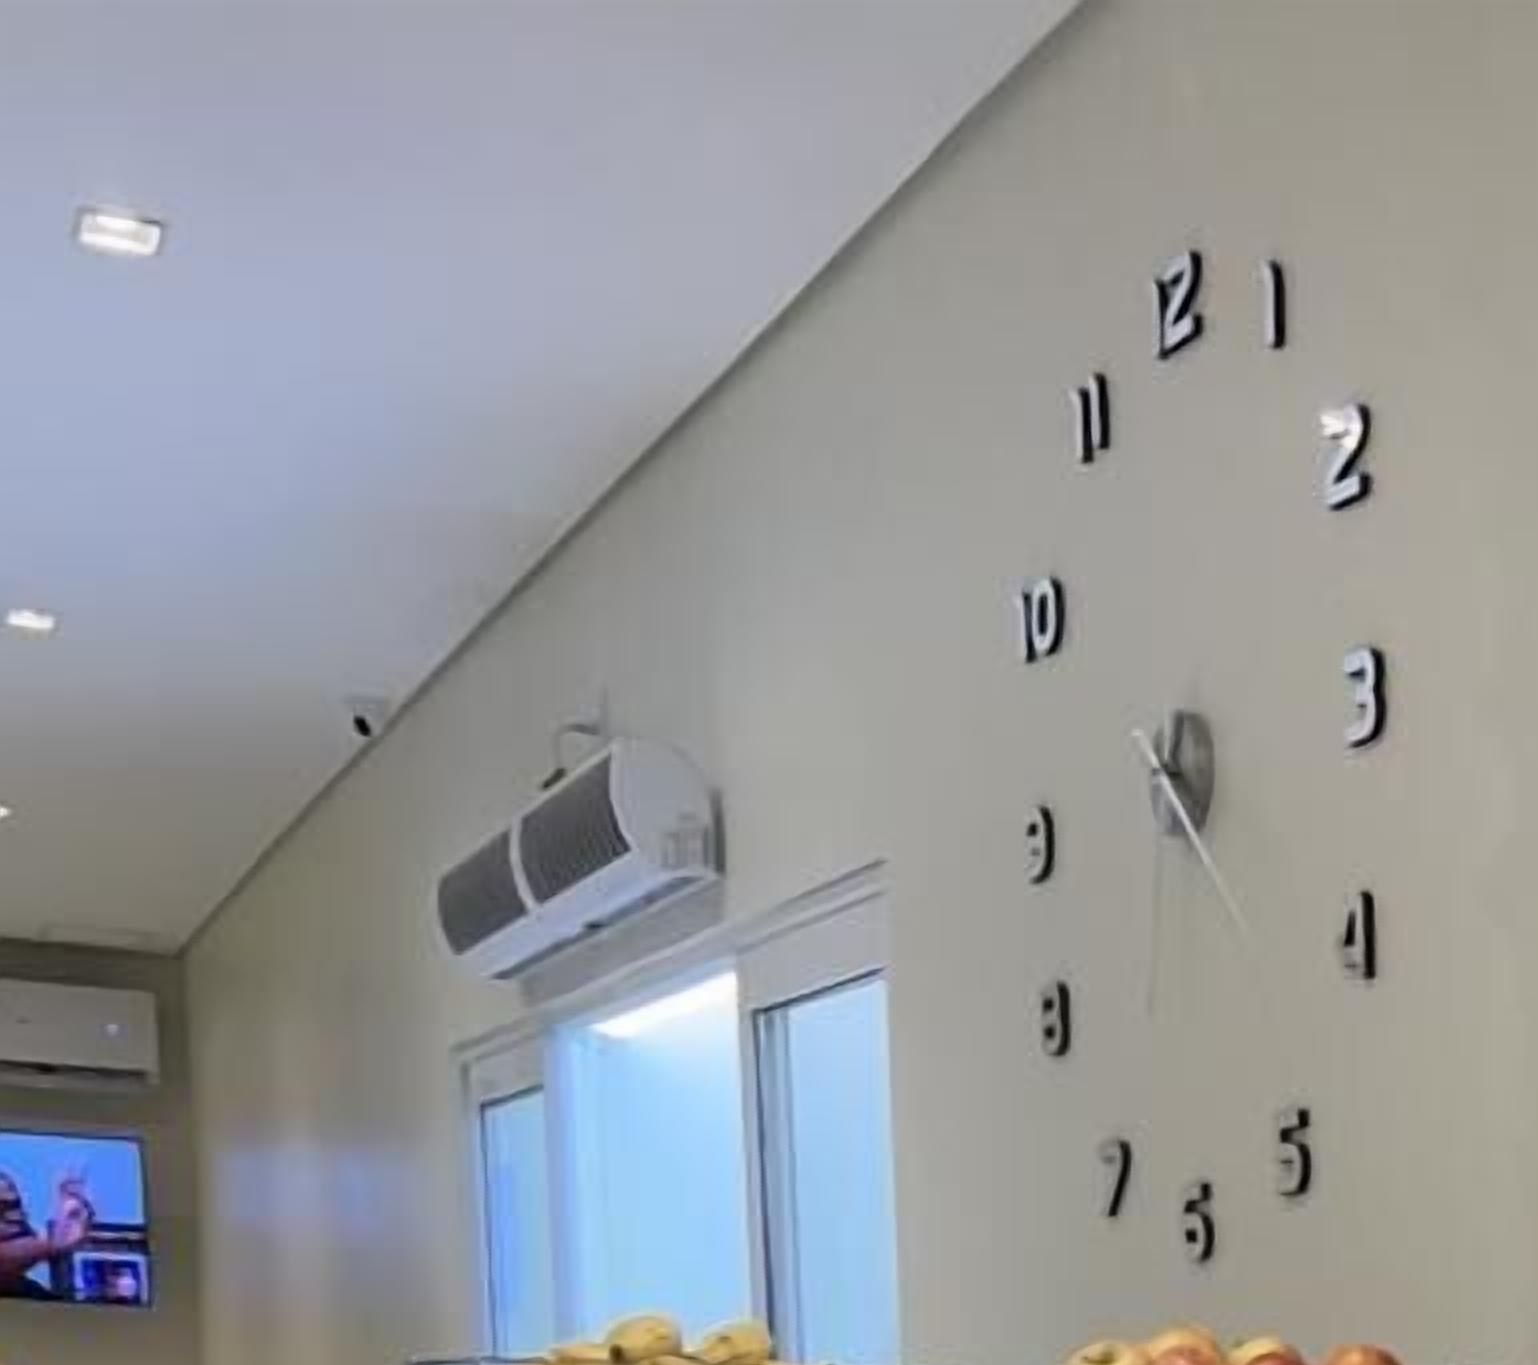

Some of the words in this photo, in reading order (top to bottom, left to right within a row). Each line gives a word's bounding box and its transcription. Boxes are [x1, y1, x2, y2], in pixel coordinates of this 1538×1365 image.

[1153, 250, 1203, 360] 12
[1264, 258, 1287, 350] 1
[1070, 371, 1111, 464] 11
[1319, 402, 1372, 512] 2
[1015, 575, 1066, 664] 10
[1343, 645, 1387, 749] 3
[1023, 804, 1056, 886] 9
[1341, 889, 1377, 981] 4
[1039, 980, 1072, 1058] 8
[1101, 1138, 1132, 1218] 7
[1278, 1106, 1313, 1198] 5
